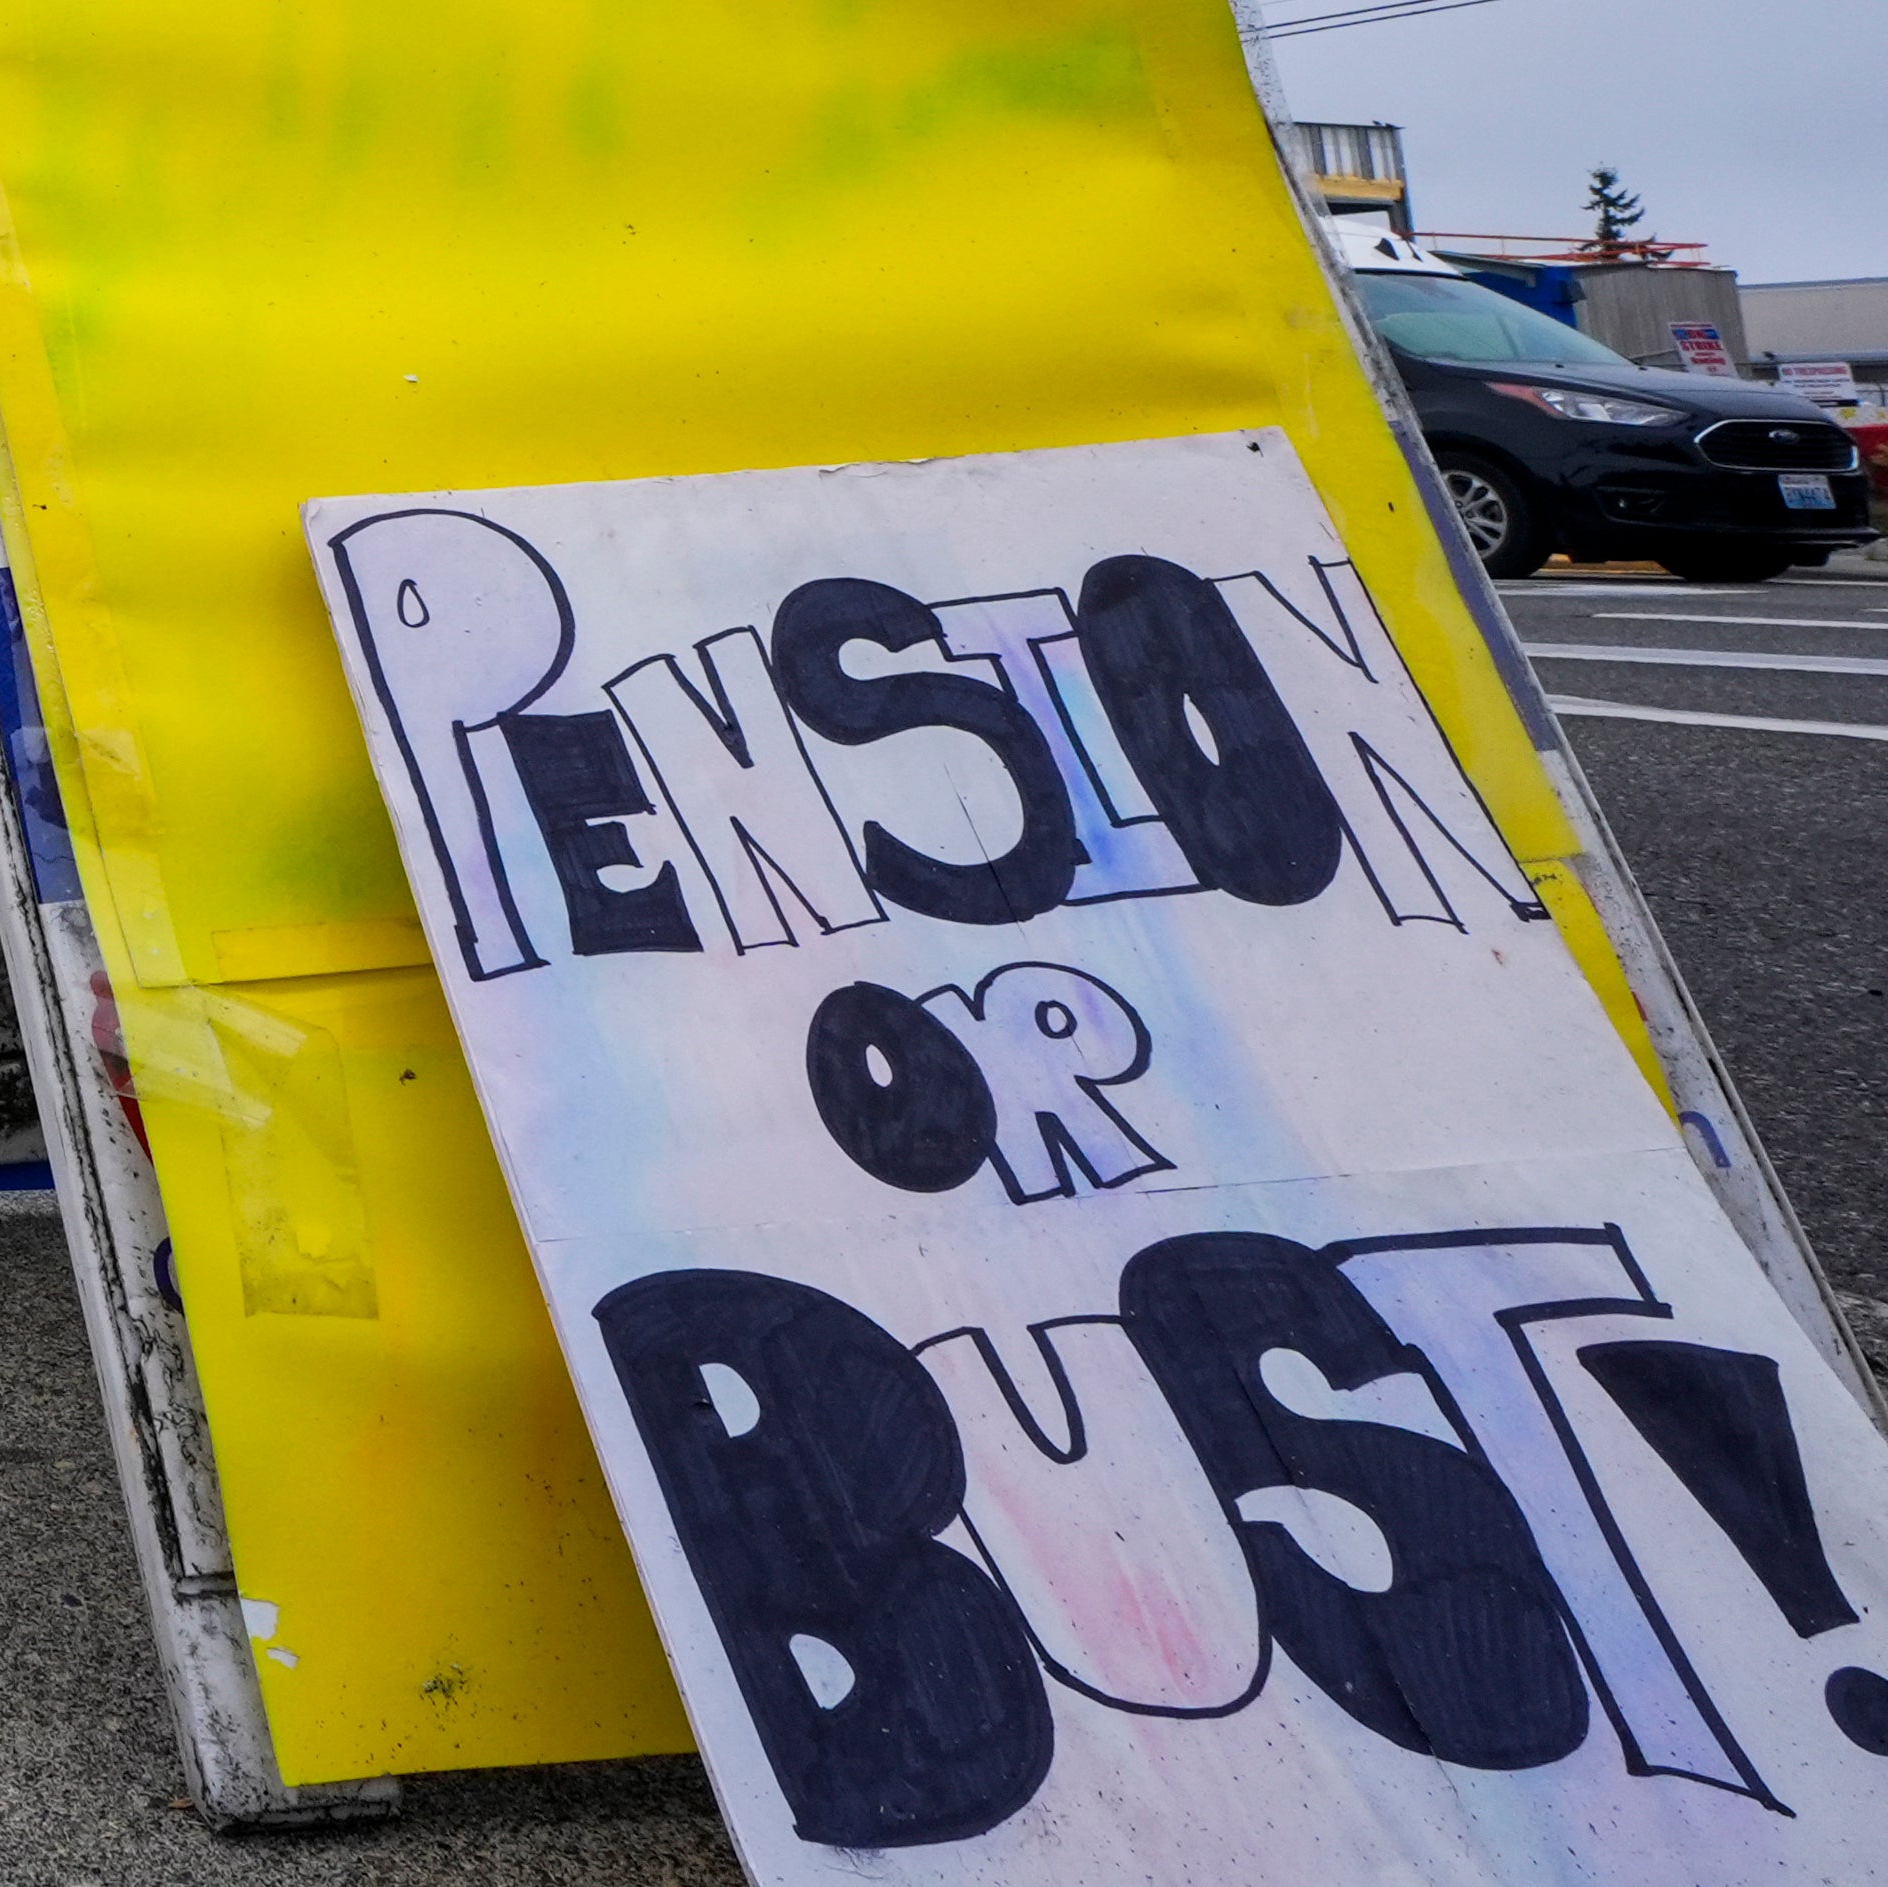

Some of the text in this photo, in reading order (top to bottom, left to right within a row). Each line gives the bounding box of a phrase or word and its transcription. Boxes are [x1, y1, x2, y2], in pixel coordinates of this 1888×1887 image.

[329, 508, 1555, 980] PENSION
[806, 961, 1178, 1204] OR
[592, 1223, 1888, 1849] BUST!
